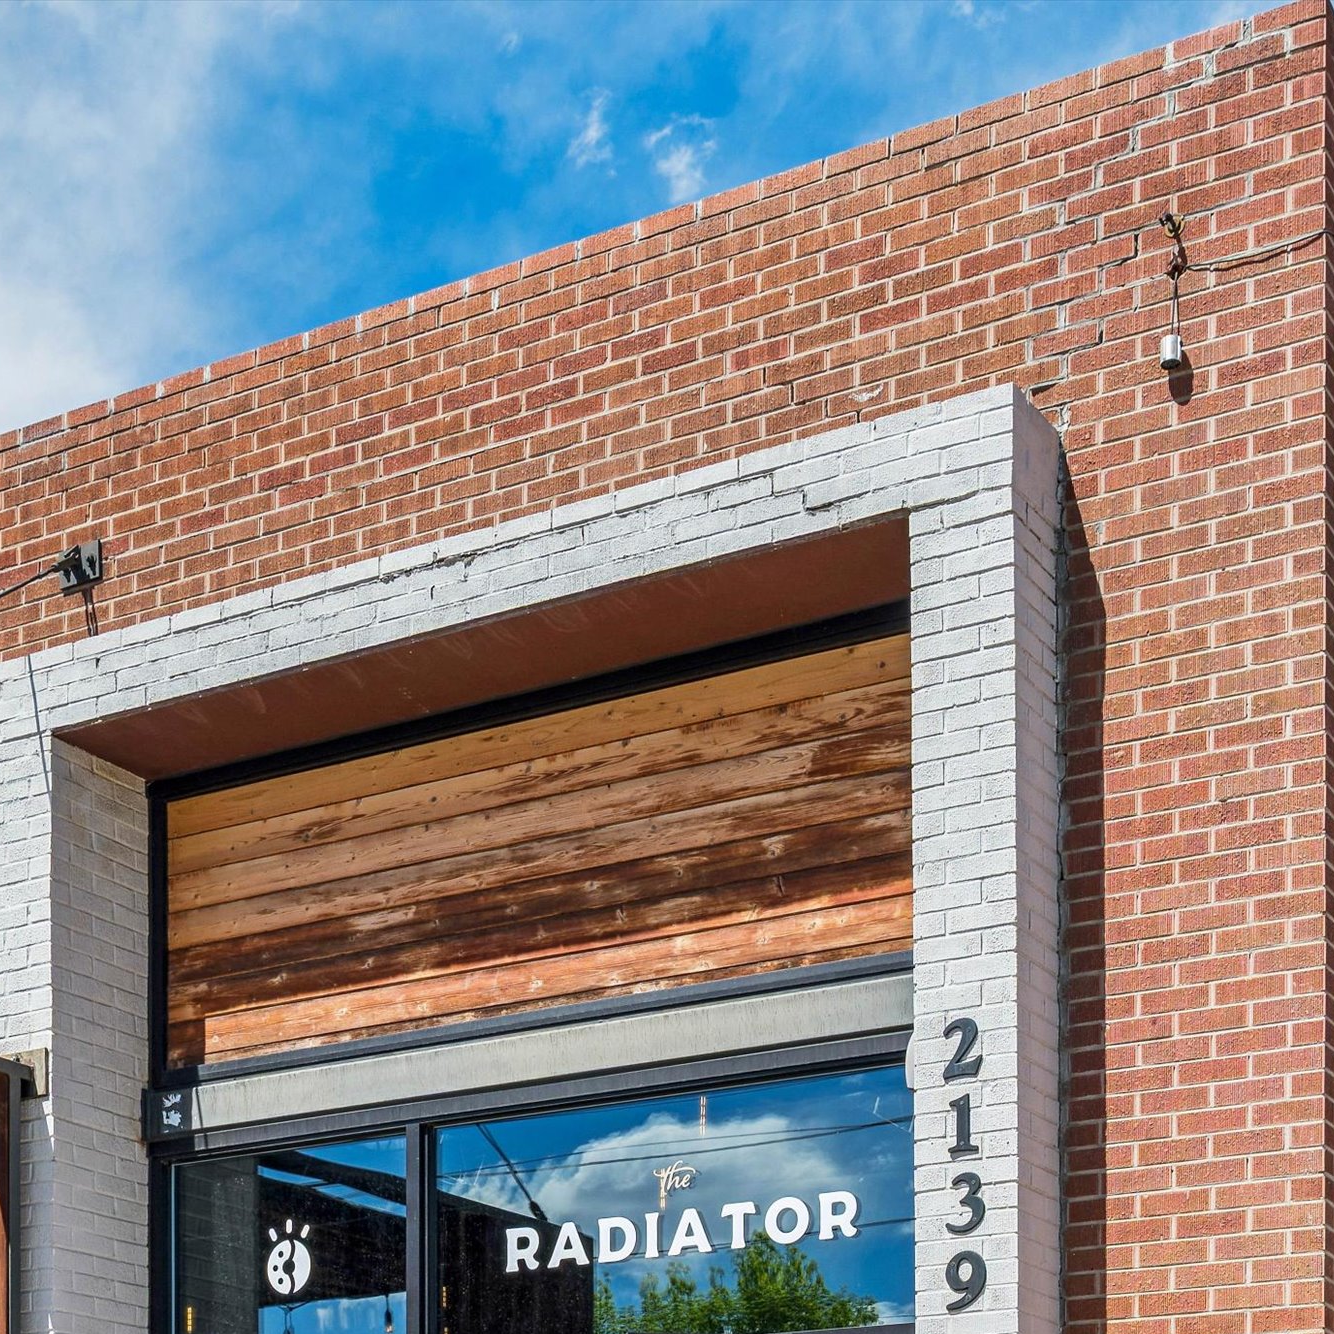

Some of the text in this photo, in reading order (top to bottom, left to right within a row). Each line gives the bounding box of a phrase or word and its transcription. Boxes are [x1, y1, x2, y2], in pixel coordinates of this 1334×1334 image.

[653, 1160, 696, 1197] the
[943, 1018, 987, 1312] 2139
[505, 1190, 859, 1273] RADIATOR
